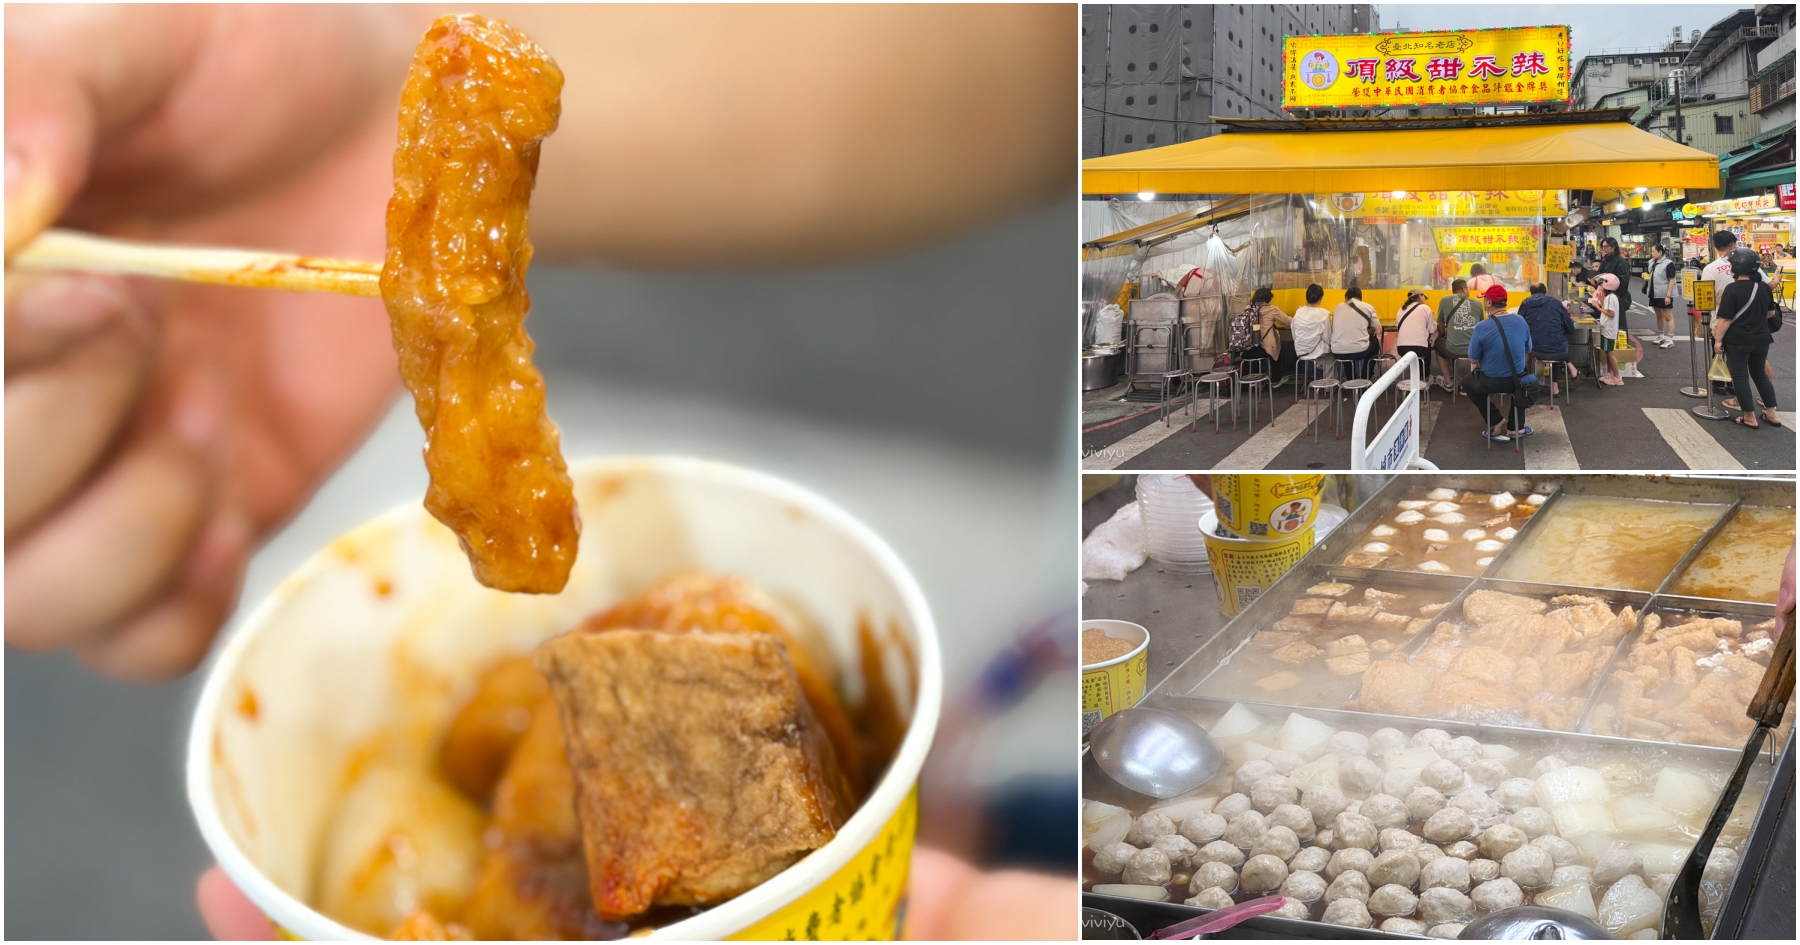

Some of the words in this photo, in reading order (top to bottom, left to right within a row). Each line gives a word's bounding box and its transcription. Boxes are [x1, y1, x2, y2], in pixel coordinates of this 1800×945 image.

[1392, 39, 1456, 52] 臺北知名老店
[1344, 50, 1551, 84] 頂級甜不辣
